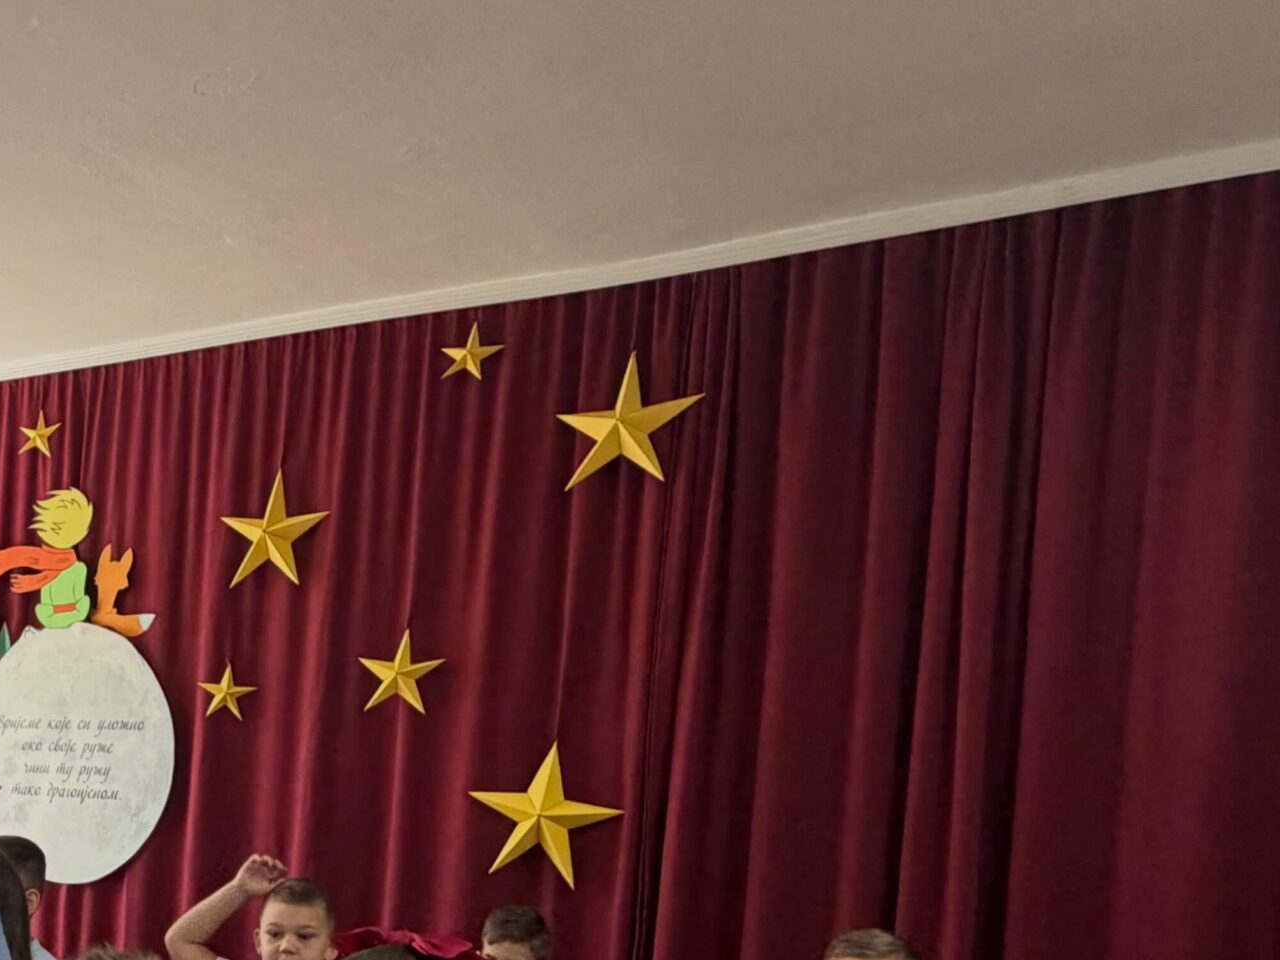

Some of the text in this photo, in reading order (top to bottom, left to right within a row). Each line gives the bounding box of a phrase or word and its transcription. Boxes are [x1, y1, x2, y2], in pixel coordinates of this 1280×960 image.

[46, 716, 73, 735] које
[77, 719, 91, 731] си
[21, 736, 114, 760] око своје руже
[76, 764, 112, 784] ружу
